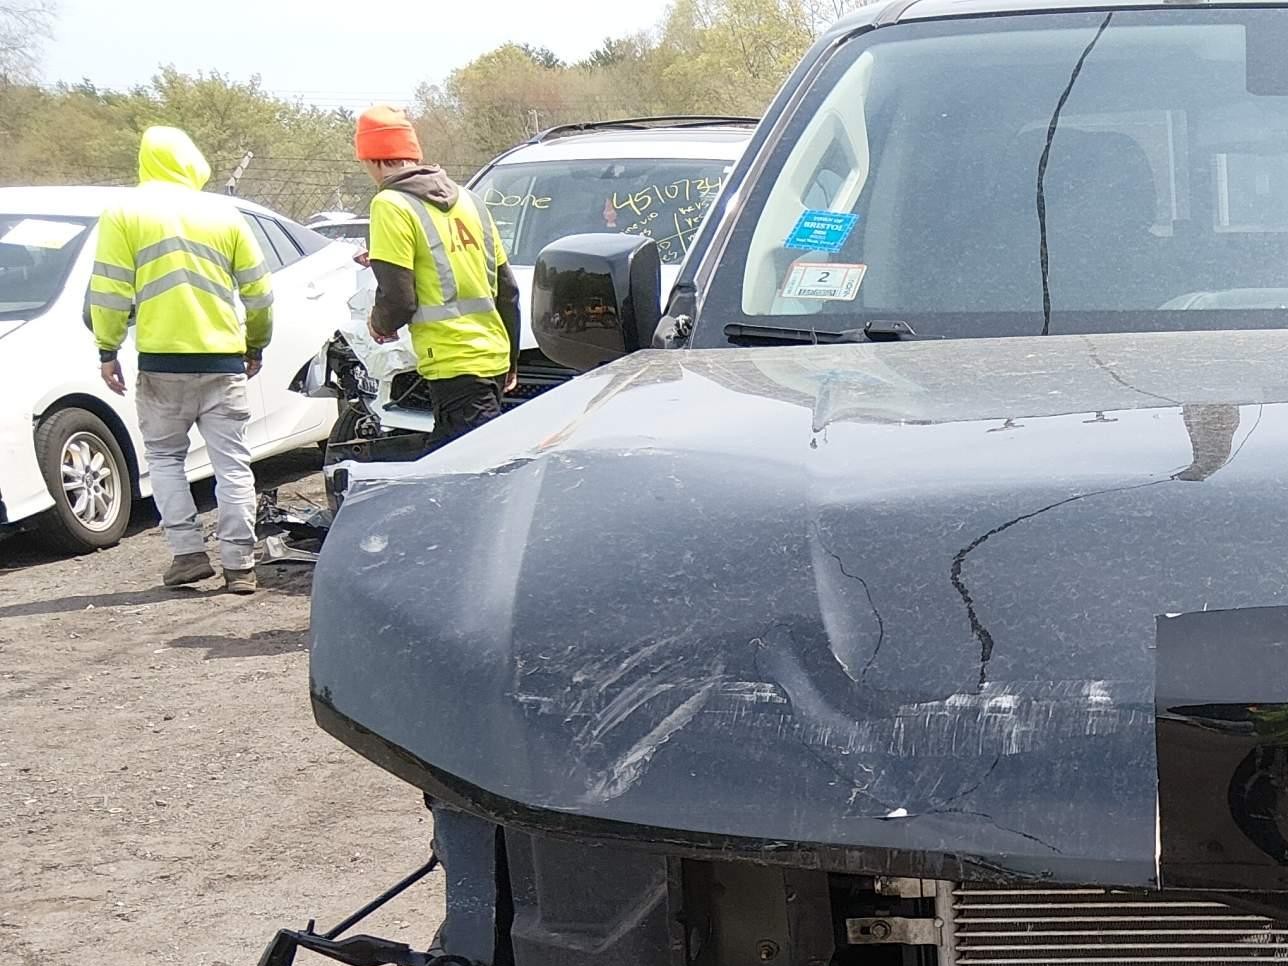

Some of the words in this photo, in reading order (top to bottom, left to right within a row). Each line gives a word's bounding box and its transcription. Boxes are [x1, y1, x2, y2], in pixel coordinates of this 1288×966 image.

[484, 188, 552, 209] Done
[804, 221, 844, 231] BRISTOL
[817, 271, 831, 283] 2
